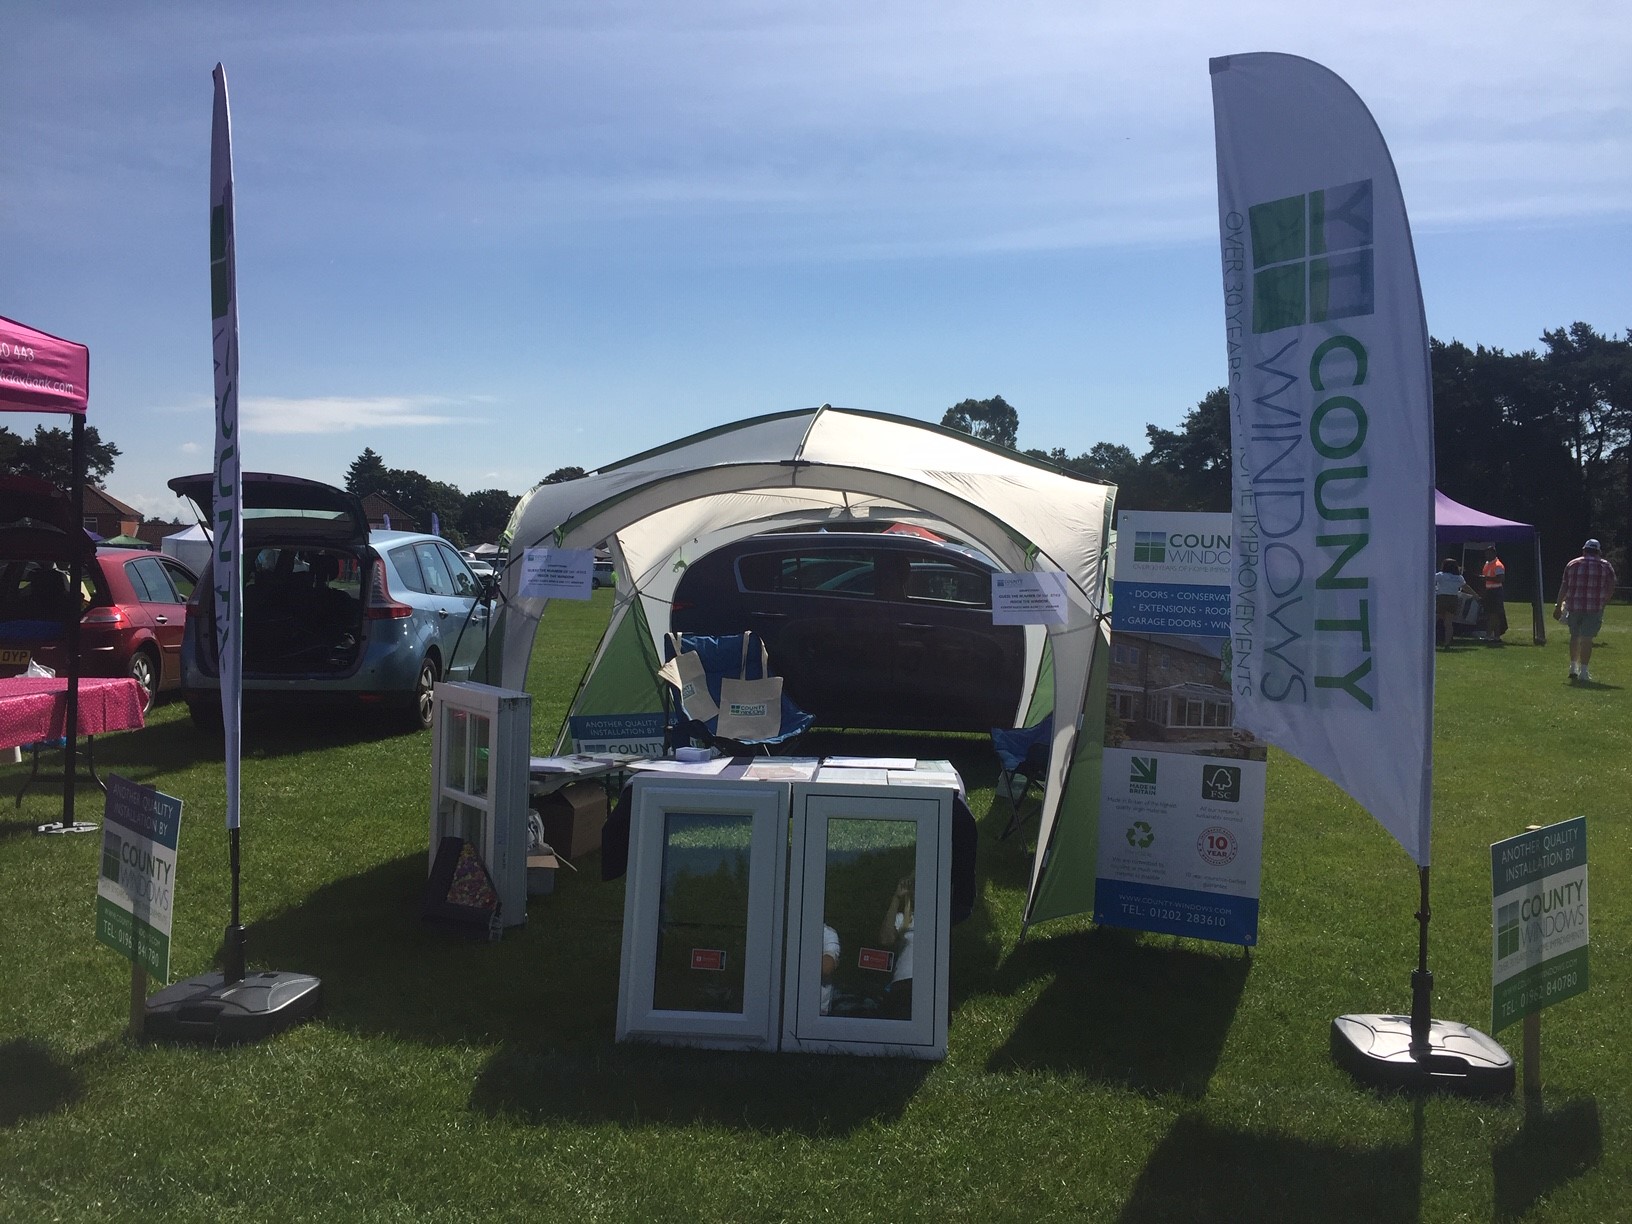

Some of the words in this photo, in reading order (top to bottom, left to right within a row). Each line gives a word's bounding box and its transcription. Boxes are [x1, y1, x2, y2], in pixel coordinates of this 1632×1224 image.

[1225, 210, 1245, 274] OVER
[1224, 277, 1243, 308] 30
[0, 342, 10, 358] 0
[14, 344, 34, 361] 443
[1251, 338, 1307, 703] WINDOWS
[1309, 334, 1374, 711] COUNTY
[1169, 533, 1231, 550] COUN
[1135, 590, 1169, 599] DOORS
[1176, 591, 1231, 602] CONSERVAT
[1138, 603, 1196, 614] EXTENSIONS
[1234, 514, 1259, 697] IMPROVEMENTS
[1127, 616, 1166, 626] GARAGE
[1168, 618, 1202, 628] DOORS
[585, 719, 622, 728] ANOTHER
[625, 719, 658, 728] QUALITY
[590, 728, 645, 736] INSTALLATION
[646, 727, 656, 735] BY
[113, 783, 141, 806] ANOTHER
[142, 796, 174, 819] QUALITY
[1129, 788, 1156, 796] BRITAIN
[1210, 790, 1232, 799] FSC
[113, 802, 158, 833] INSTALLATION
[158, 821, 169, 837] BY
[1206, 849, 1228, 858] YEAR
[1207, 836, 1228, 850] 10
[1501, 840, 1541, 865] ANOTHER
[1543, 826, 1579, 849] QUALITY
[121, 841, 172, 886] COUNTY
[1505, 853, 1563, 883] INSTALLATION
[1565, 846, 1575, 861] BY
[119, 866, 169, 911] WINDOWS
[1521, 879, 1584, 922] COUNTY
[1122, 904, 1146, 917] TEL:
[1150, 907, 1182, 921] 01202
[1186, 912, 1227, 928] 283610
[1519, 903, 1585, 947] WINDOWS
[1520, 985, 1544, 1008] 01962
[1546, 971, 1578, 996] 840780
